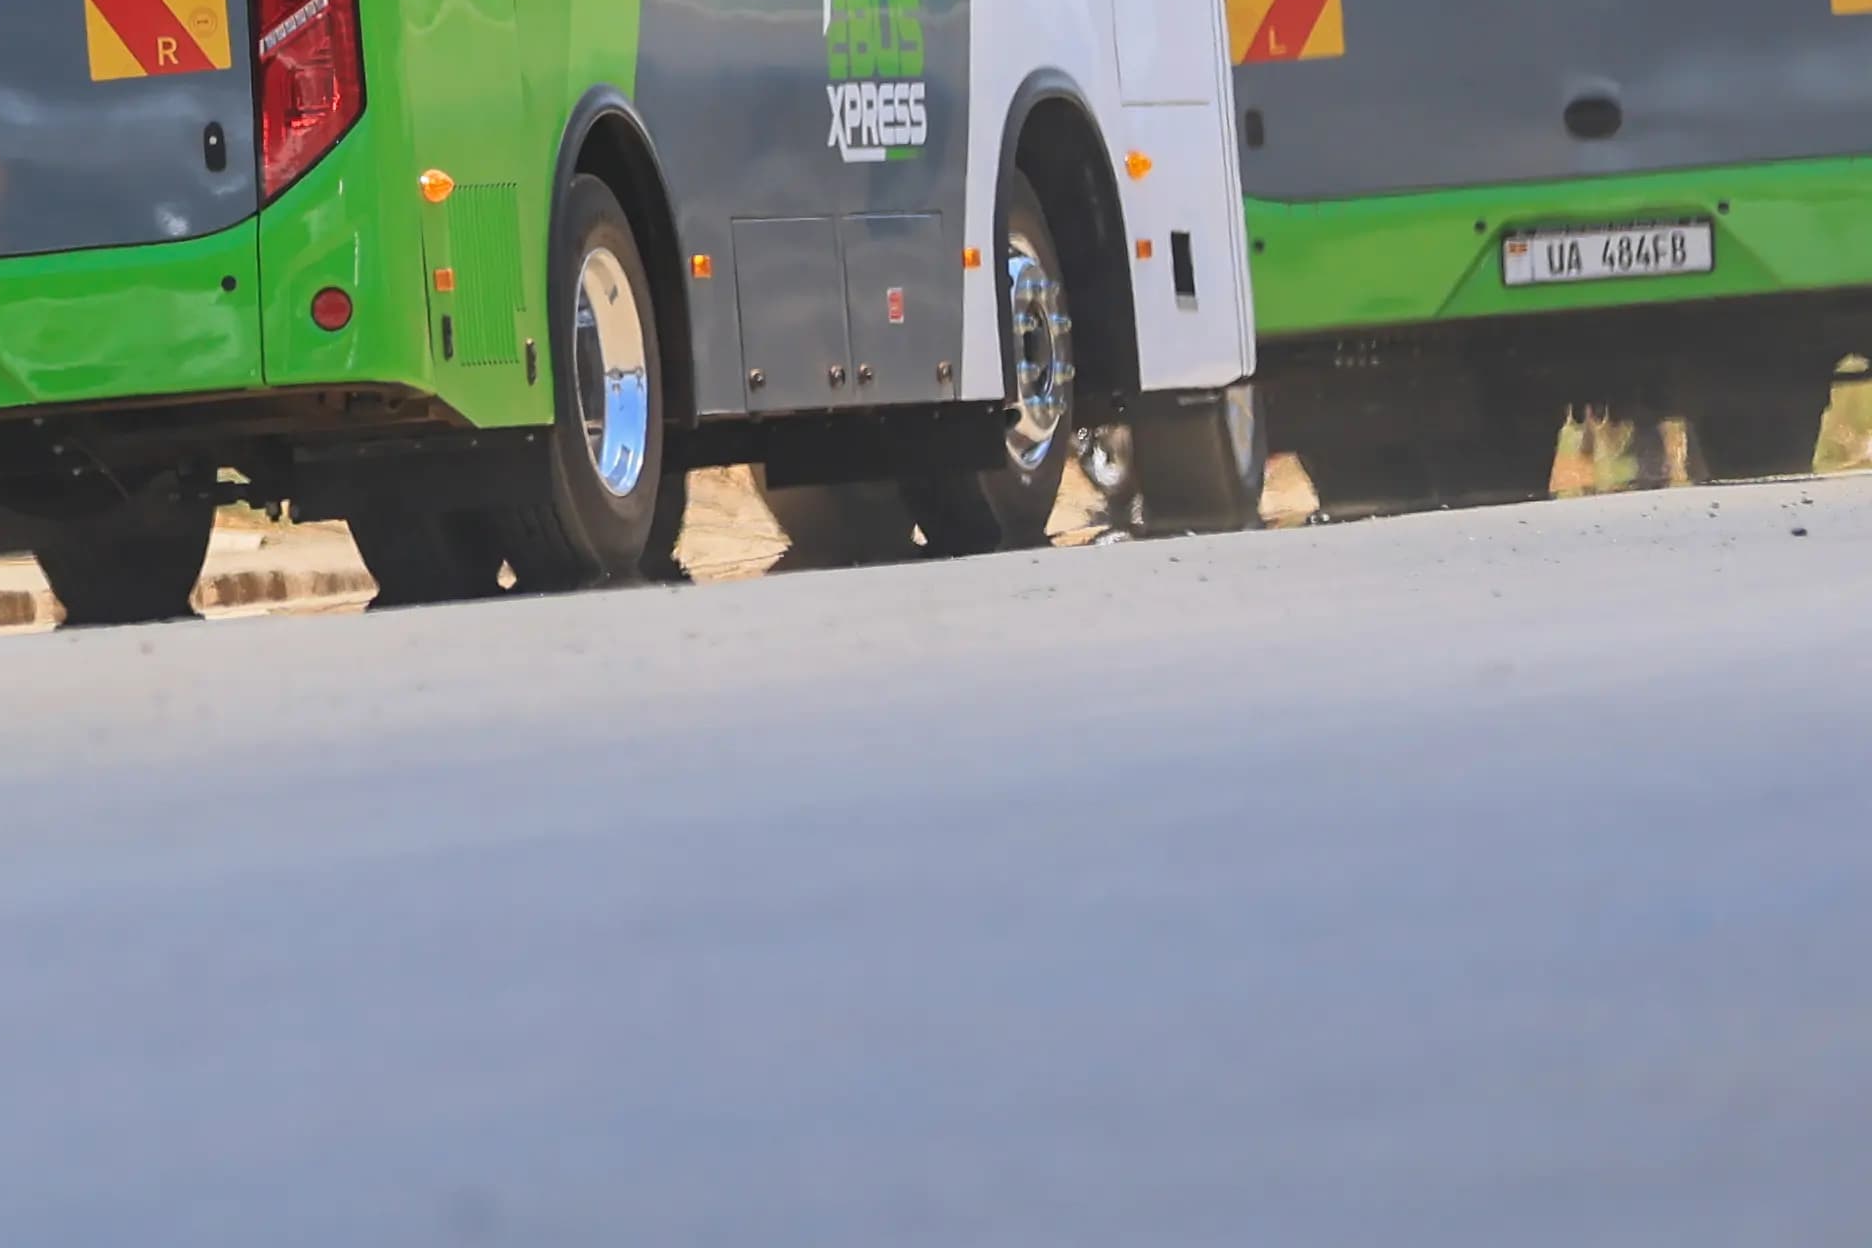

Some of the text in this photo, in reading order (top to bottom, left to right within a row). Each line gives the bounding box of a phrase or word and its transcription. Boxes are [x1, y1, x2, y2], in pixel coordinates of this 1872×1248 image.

[156, 36, 180, 67] R
[1268, 24, 1287, 56] L
[826, 82, 928, 163] XPRESS
[1547, 241, 1583, 275] UA
